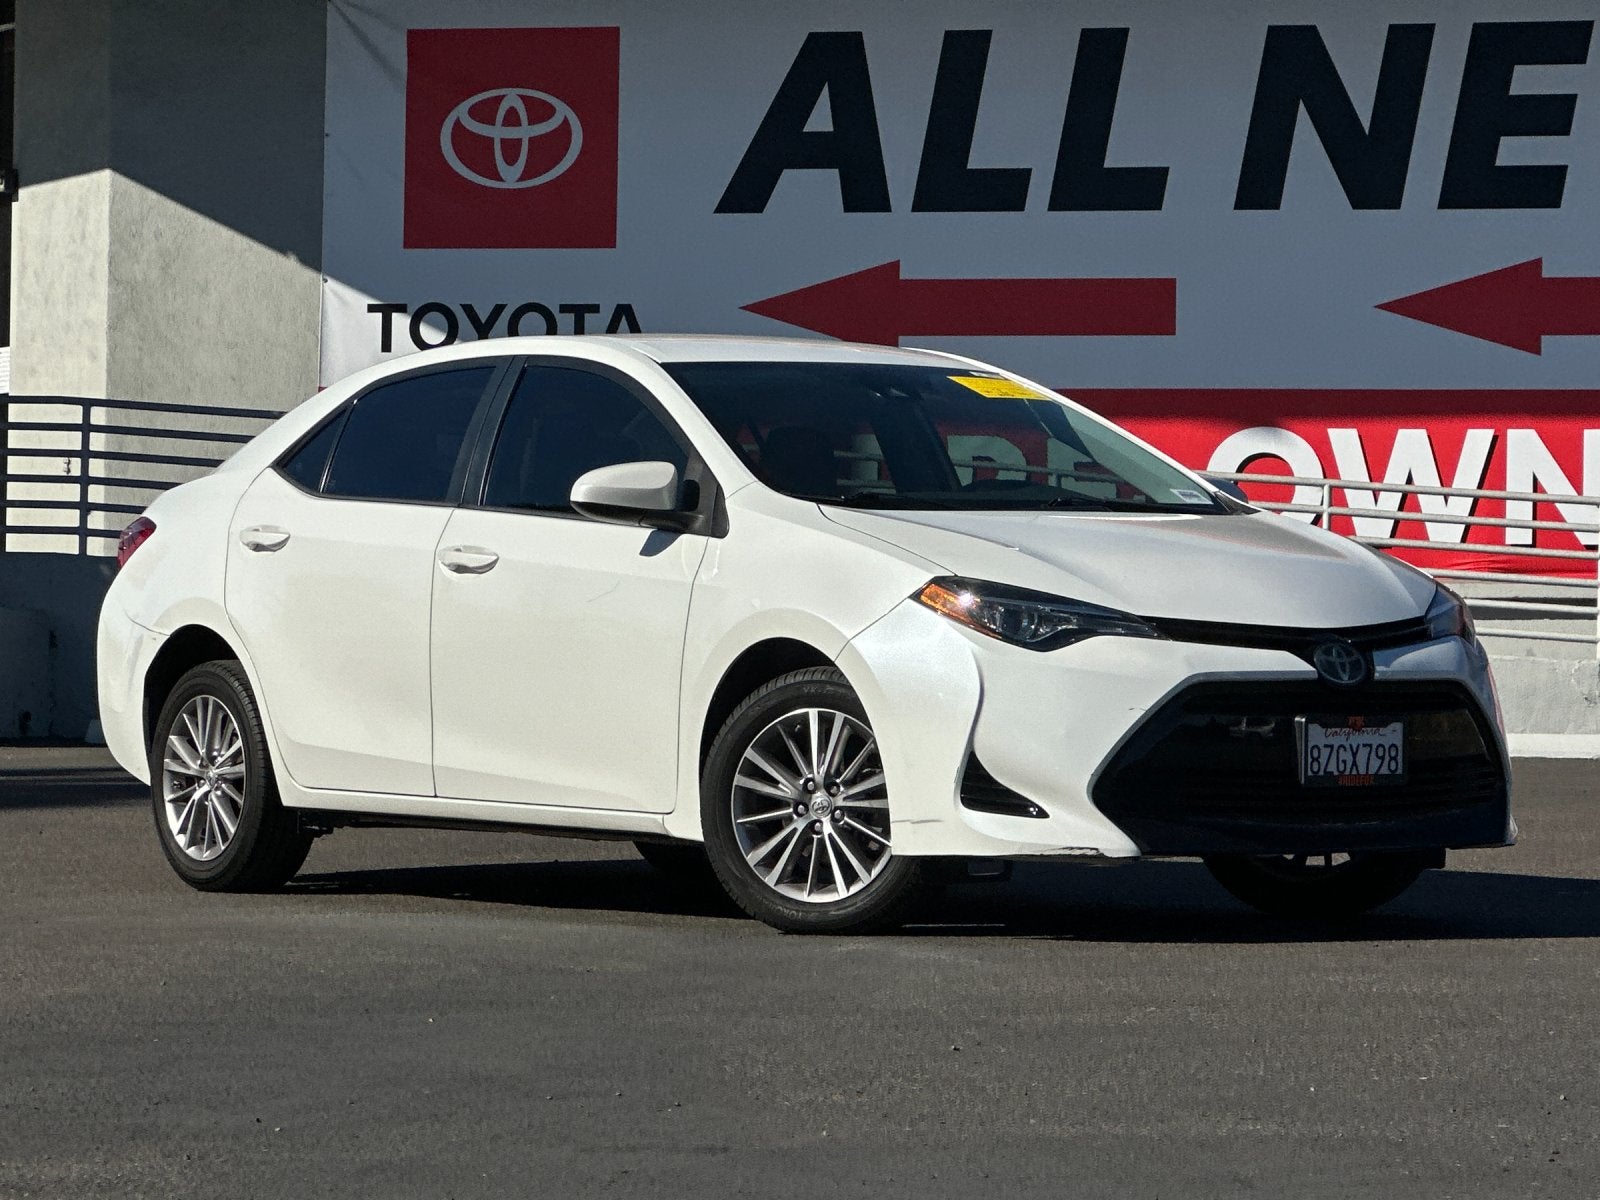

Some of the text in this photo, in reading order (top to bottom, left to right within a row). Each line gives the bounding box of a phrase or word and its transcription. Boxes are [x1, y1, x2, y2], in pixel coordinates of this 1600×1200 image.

[713, 20, 1595, 214] ALL NE
[367, 301, 642, 353] TOYOTA
[1309, 743, 1399, 775] 8ZGX798
